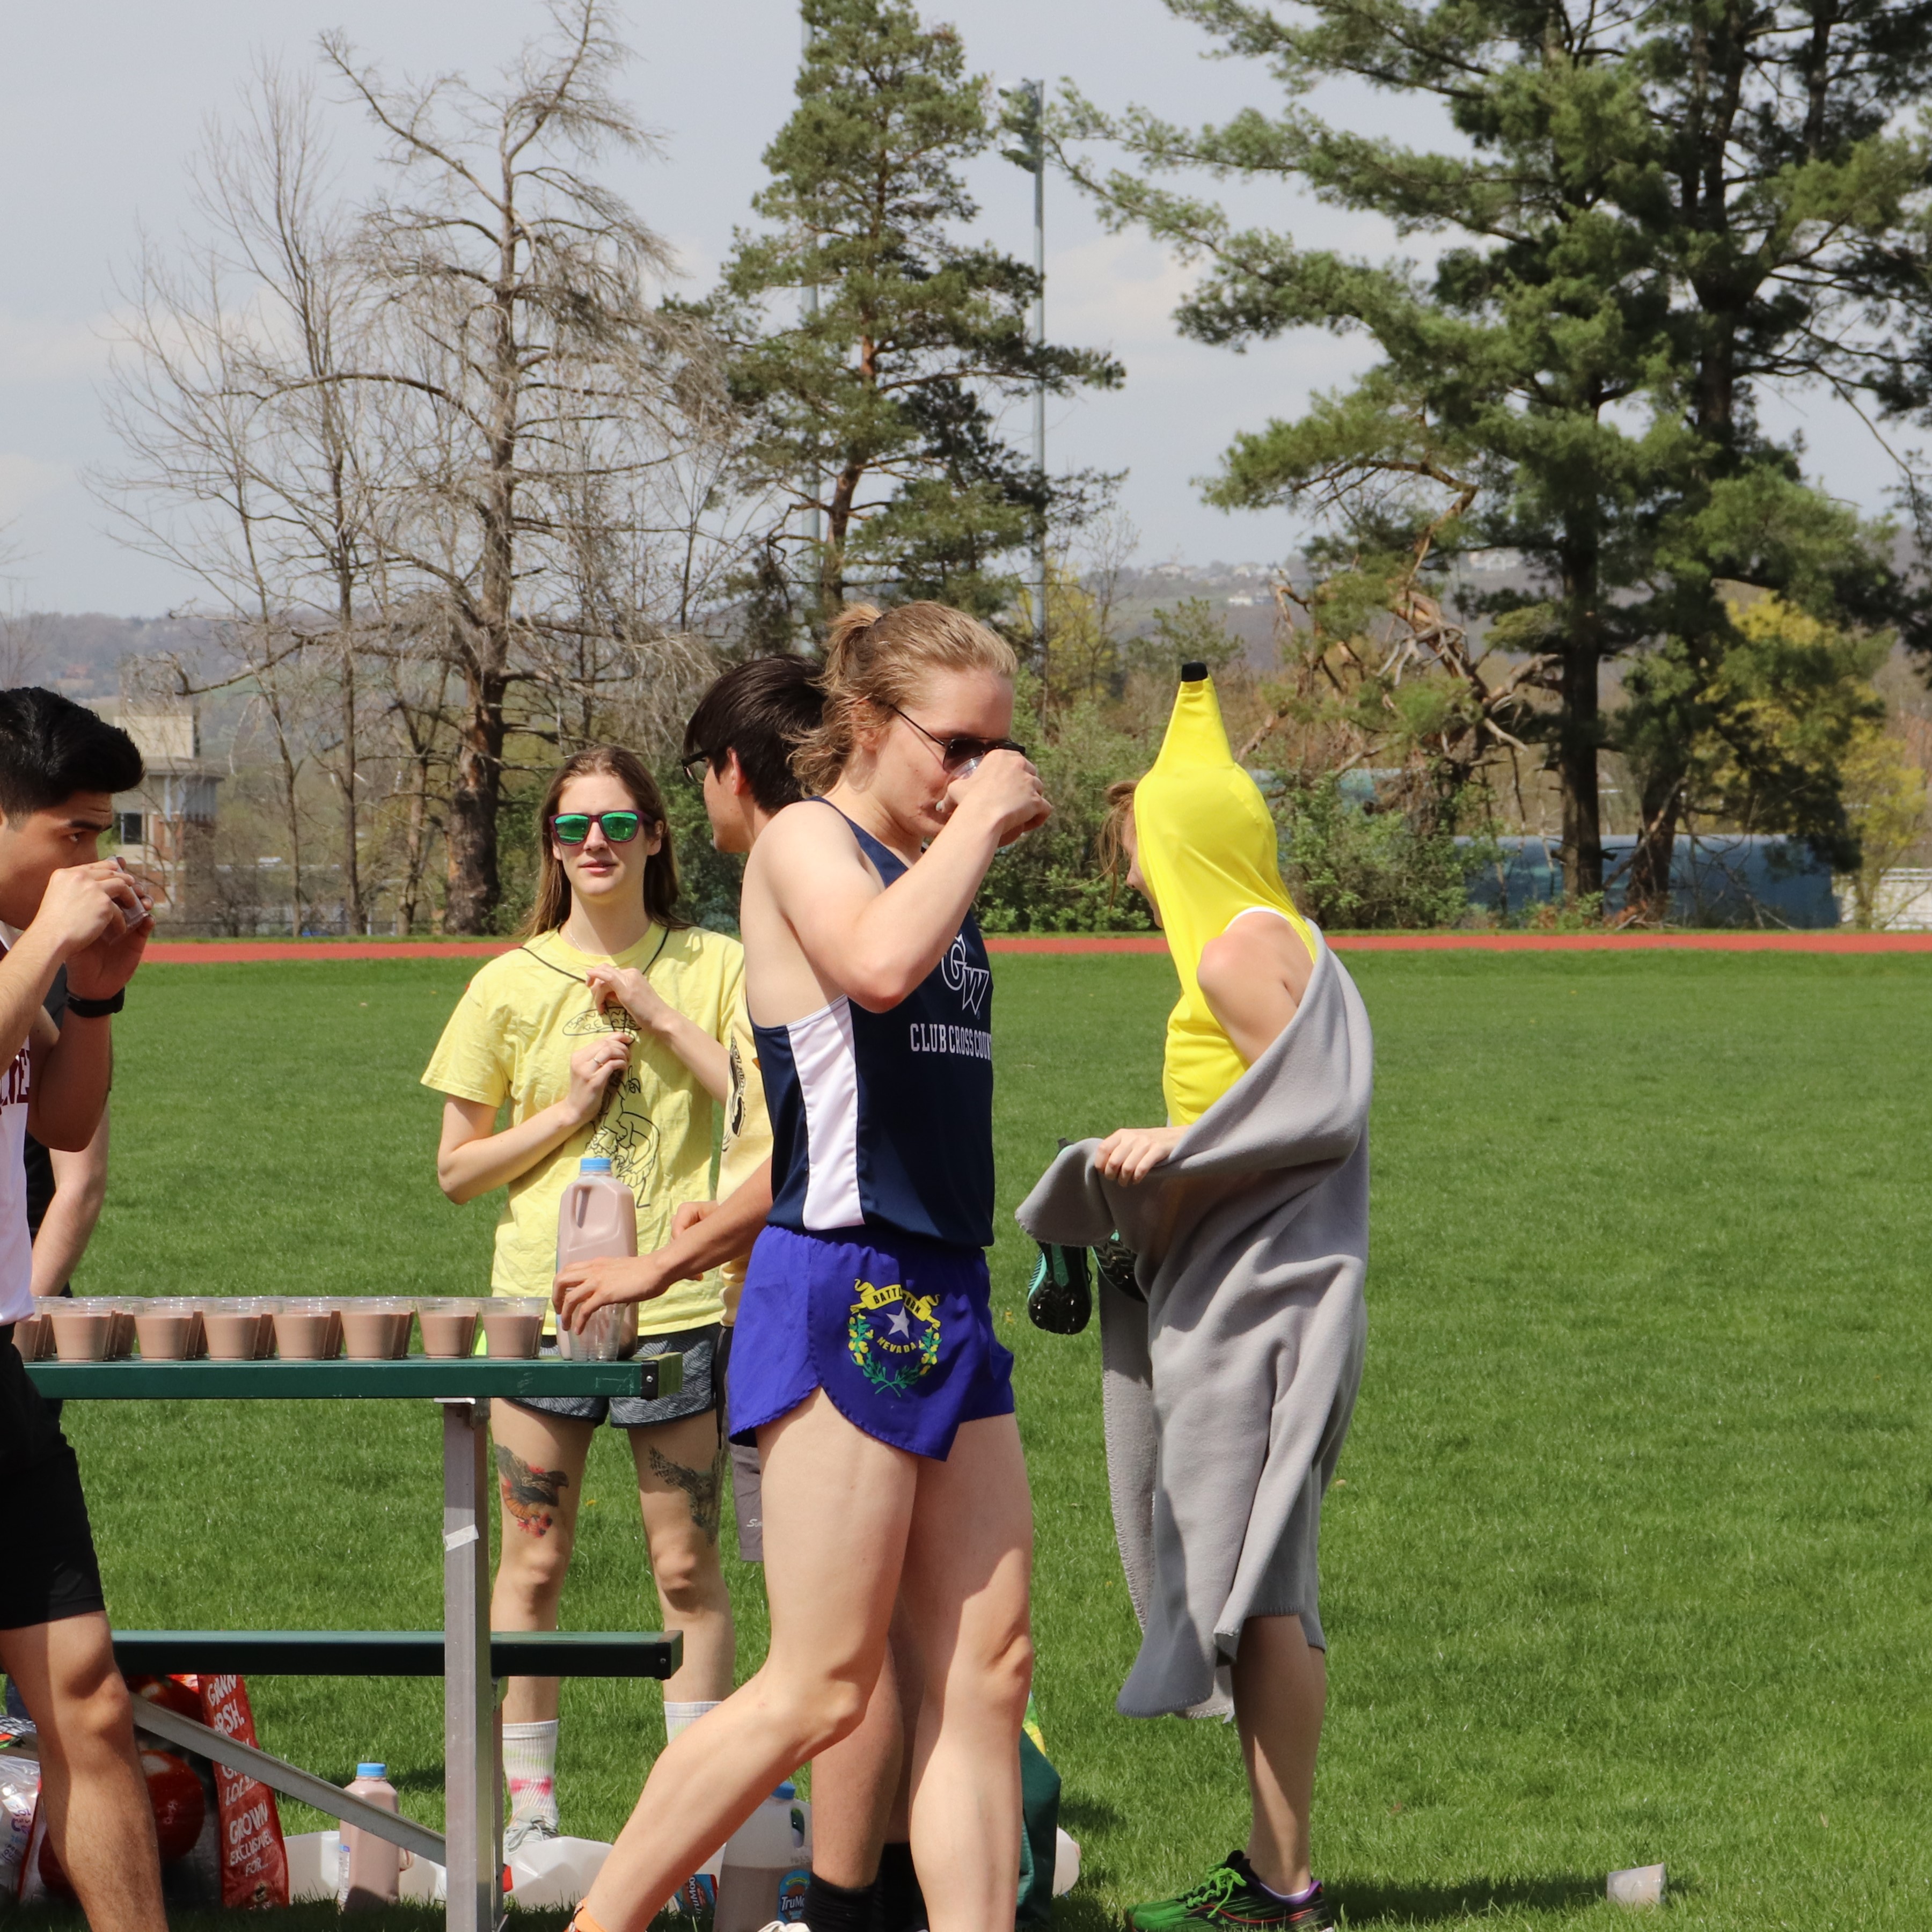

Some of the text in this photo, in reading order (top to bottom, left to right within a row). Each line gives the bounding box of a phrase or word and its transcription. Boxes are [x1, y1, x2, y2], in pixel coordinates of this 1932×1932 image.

[941, 933, 990, 1015] GW
[910, 1023, 947, 1052] CLUB
[948, 1024, 974, 1057] CROSS
[873, 1287, 902, 1305] BATTL
[876, 1336, 917, 1353] NEVADA
[229, 1799, 268, 1845] GROWN
[781, 1896, 804, 1912] TruM
